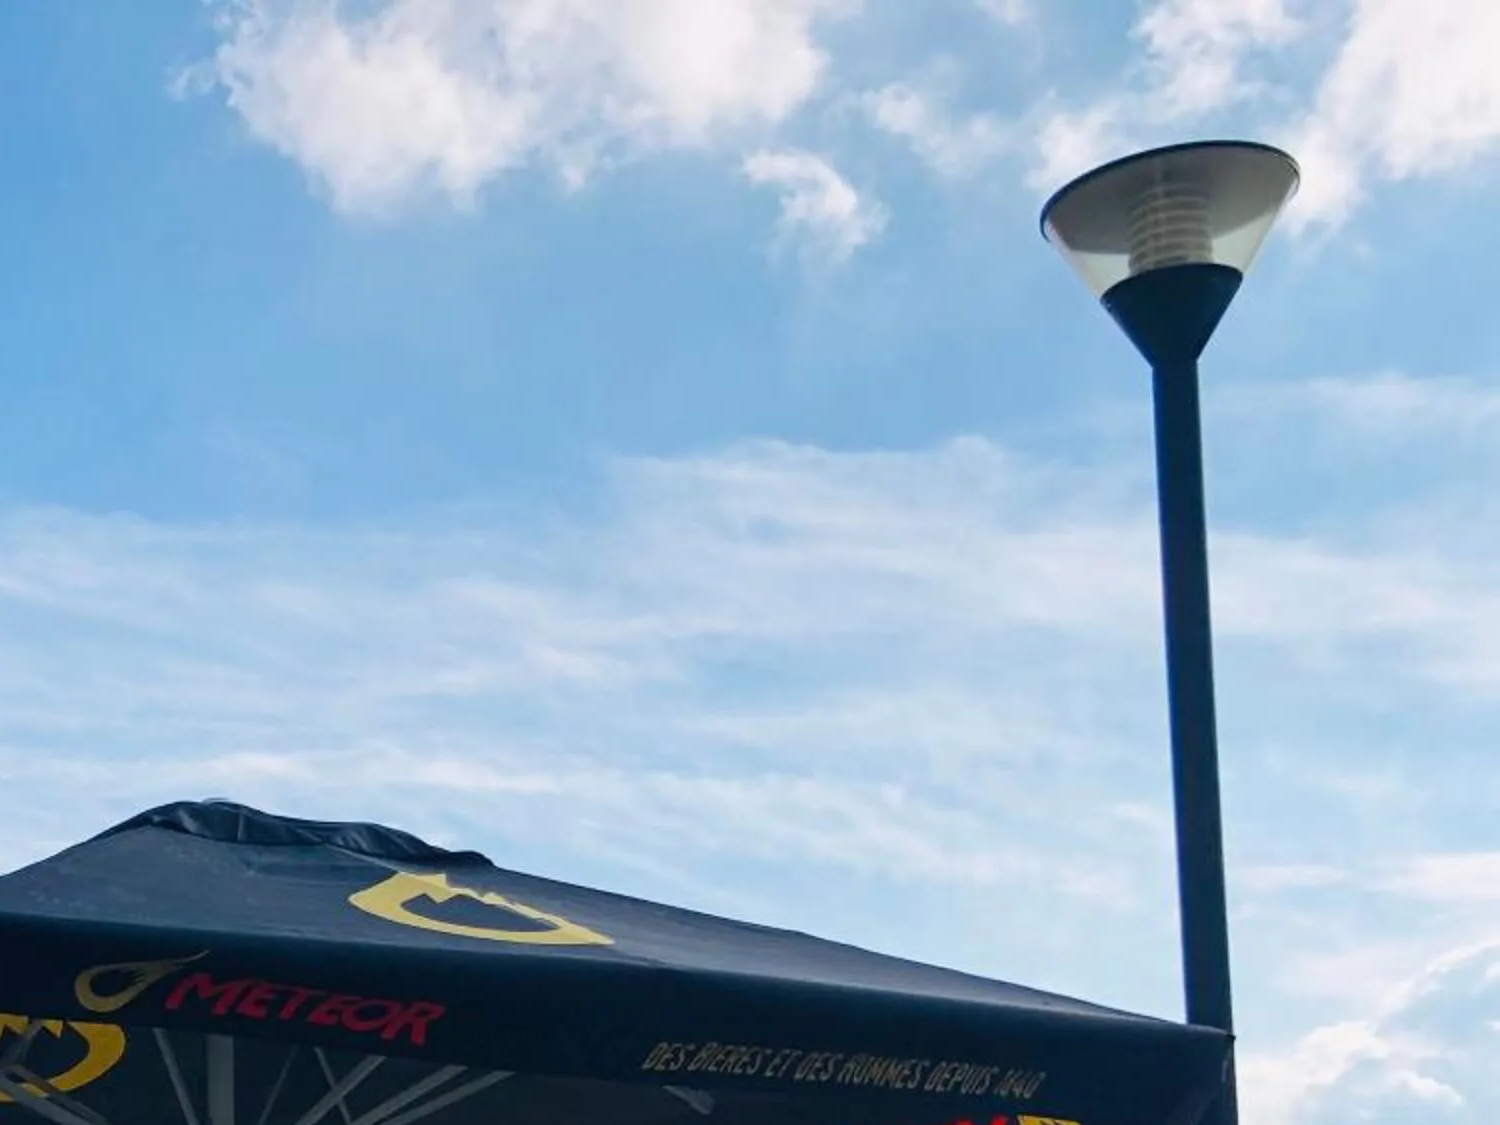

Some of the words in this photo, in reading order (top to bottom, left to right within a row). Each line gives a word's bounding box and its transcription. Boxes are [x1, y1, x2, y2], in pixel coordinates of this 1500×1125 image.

[164, 972, 446, 1047] METEOR
[641, 1041, 697, 1072] DES
[763, 1049, 803, 1079] ET
[794, 1051, 844, 1083] DES
[923, 1060, 1000, 1096] DEPUIS
